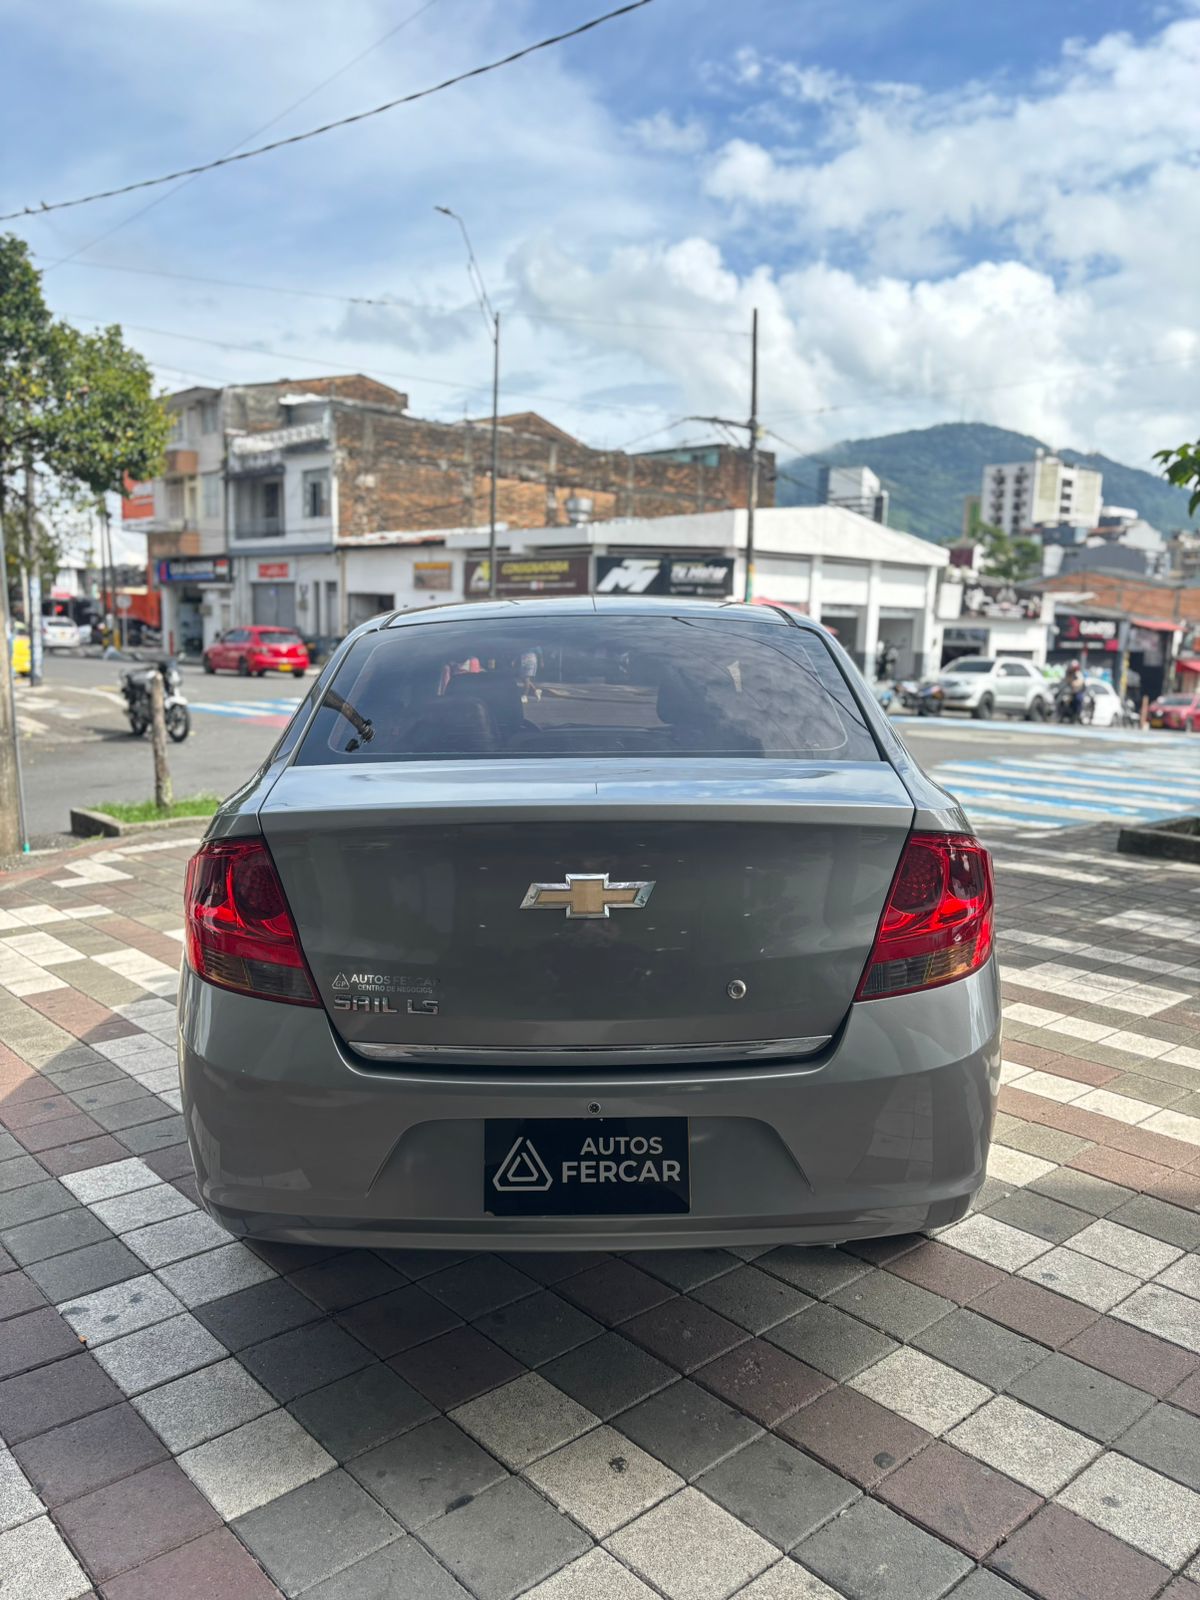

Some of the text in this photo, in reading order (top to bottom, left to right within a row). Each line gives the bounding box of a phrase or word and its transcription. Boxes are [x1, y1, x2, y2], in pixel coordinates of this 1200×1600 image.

[350, 973, 391, 985] AUTOS
[334, 994, 439, 1015] SAIL LS
[580, 1136, 663, 1156] AUTOS
[562, 1160, 681, 1183] FERCAR
